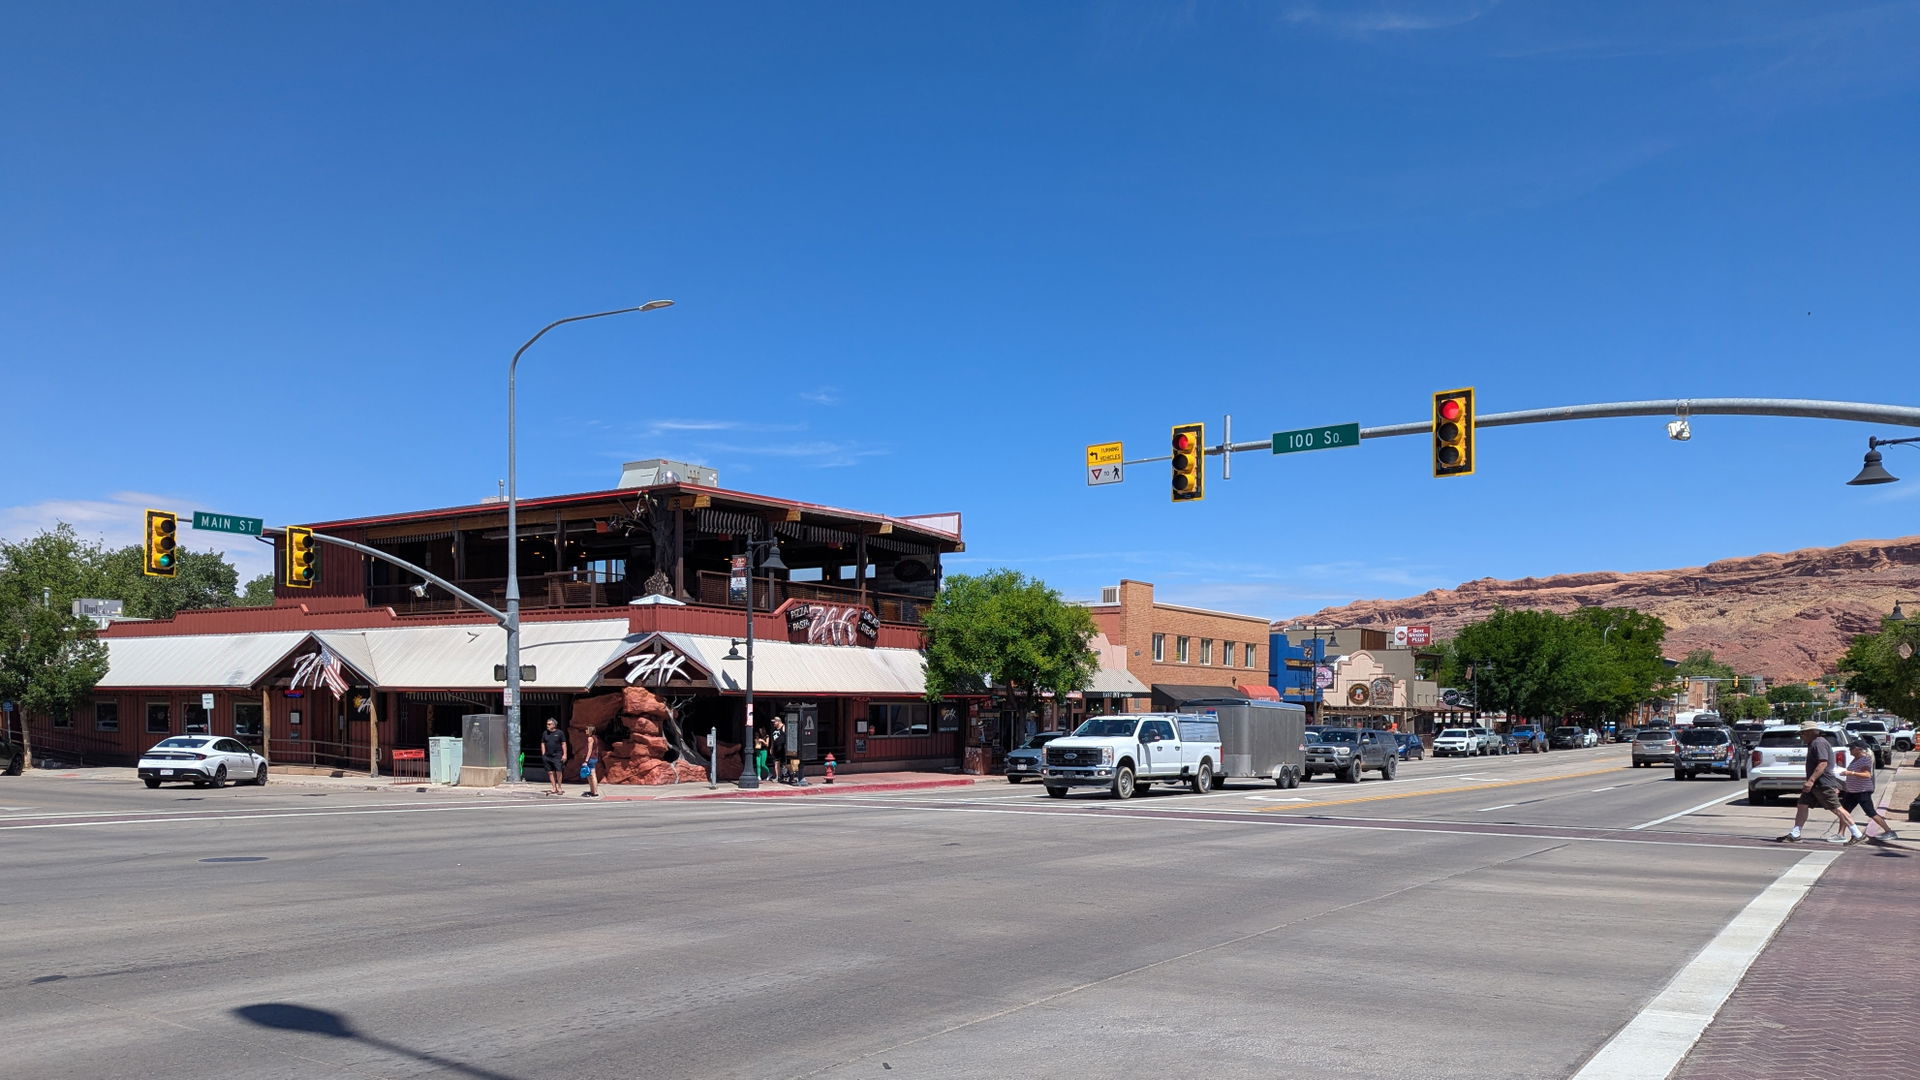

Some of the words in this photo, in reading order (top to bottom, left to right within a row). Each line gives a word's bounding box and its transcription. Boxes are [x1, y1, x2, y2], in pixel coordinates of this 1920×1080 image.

[1289, 433, 1314, 449] 100
[1324, 430, 1343, 445] So.
[201, 515, 231, 530] MAIN
[790, 606, 809, 619] PIZZA
